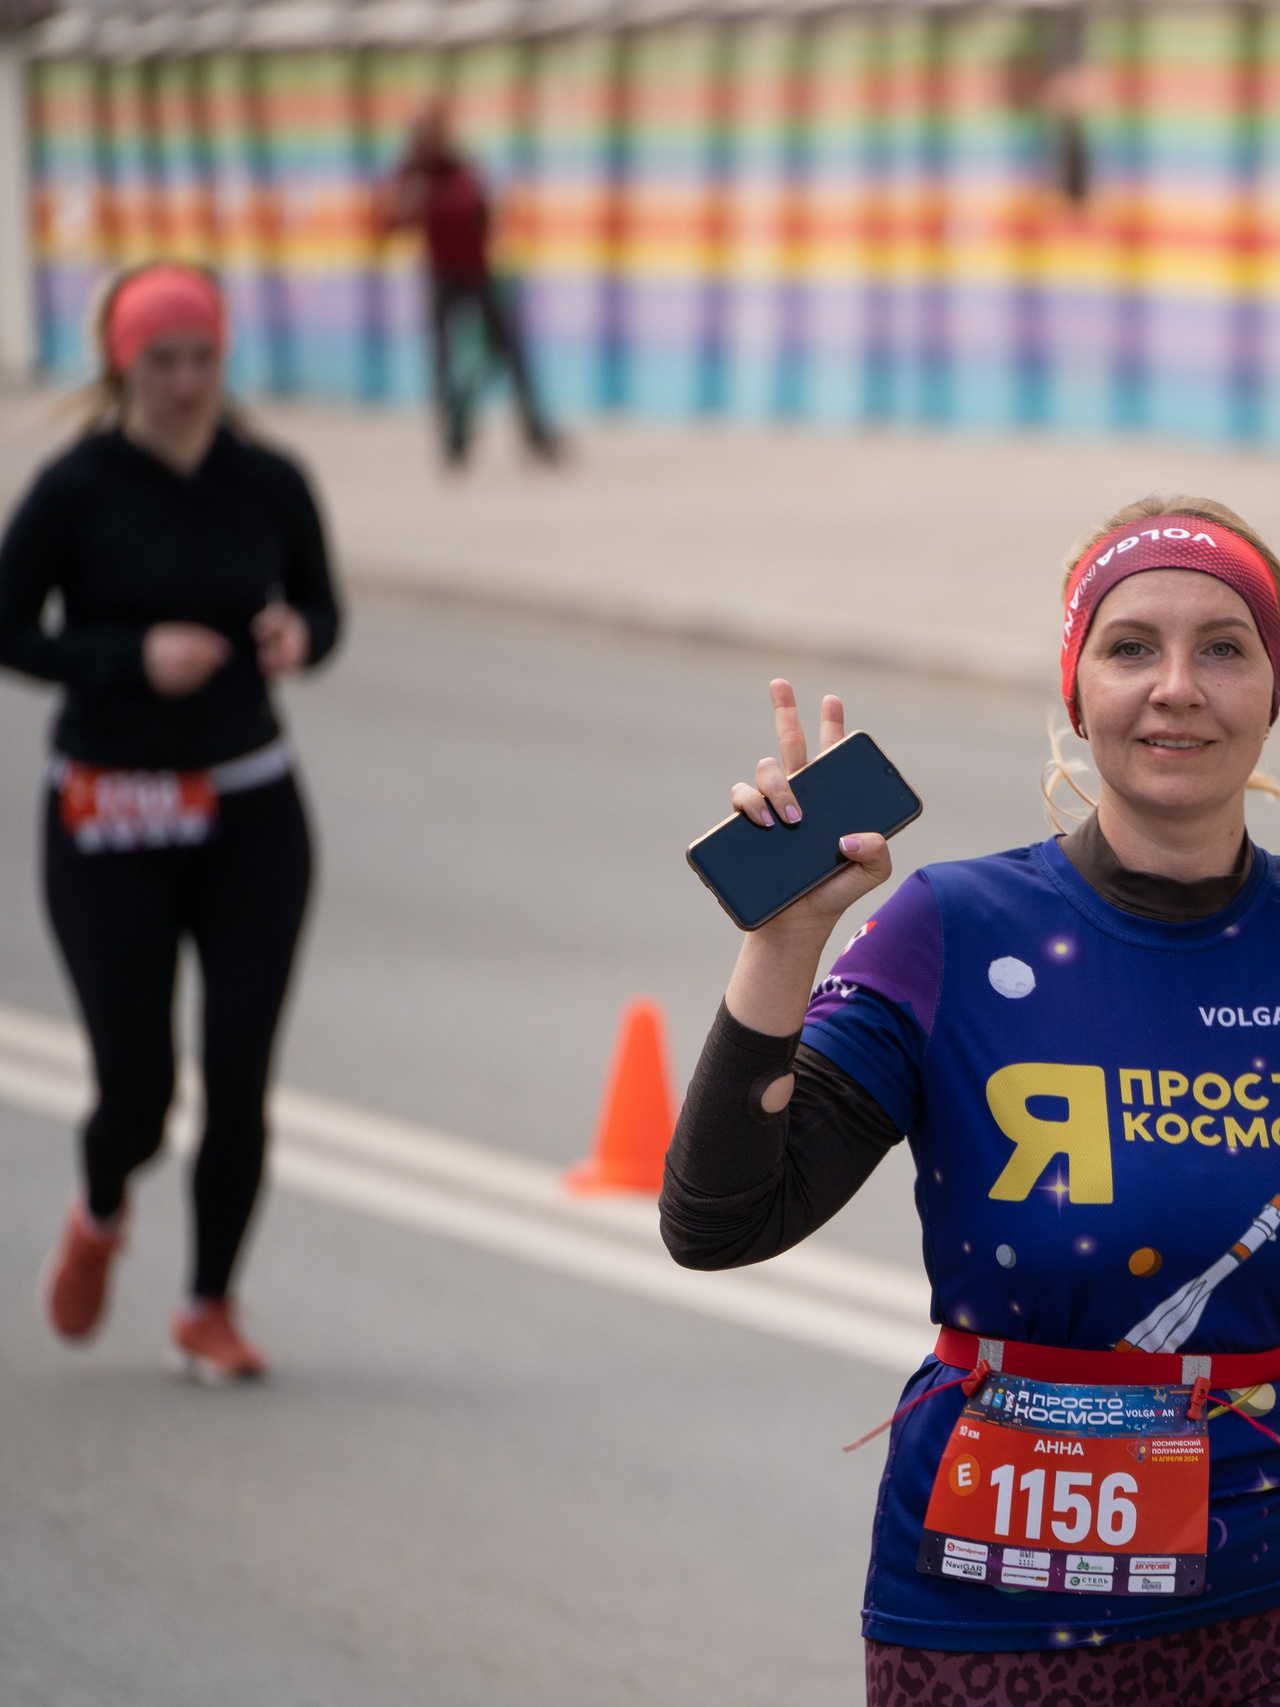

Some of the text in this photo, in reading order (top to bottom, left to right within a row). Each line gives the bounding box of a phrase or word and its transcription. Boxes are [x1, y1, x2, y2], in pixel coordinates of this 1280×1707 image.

[986, 1062, 1114, 1205] Я
[1017, 1390, 1124, 1410] Я ПРОСТО
[1014, 1403, 1125, 1425] КОСМОС
[959, 1425, 969, 1437] 10
[1034, 1438, 1085, 1456] АННА
[1151, 1439, 1201, 1447] КОСМИЧЕСКИЙ
[957, 1462, 973, 1487] E
[990, 1464, 1138, 1545] 1156
[945, 1560, 983, 1573] NaviGAR
